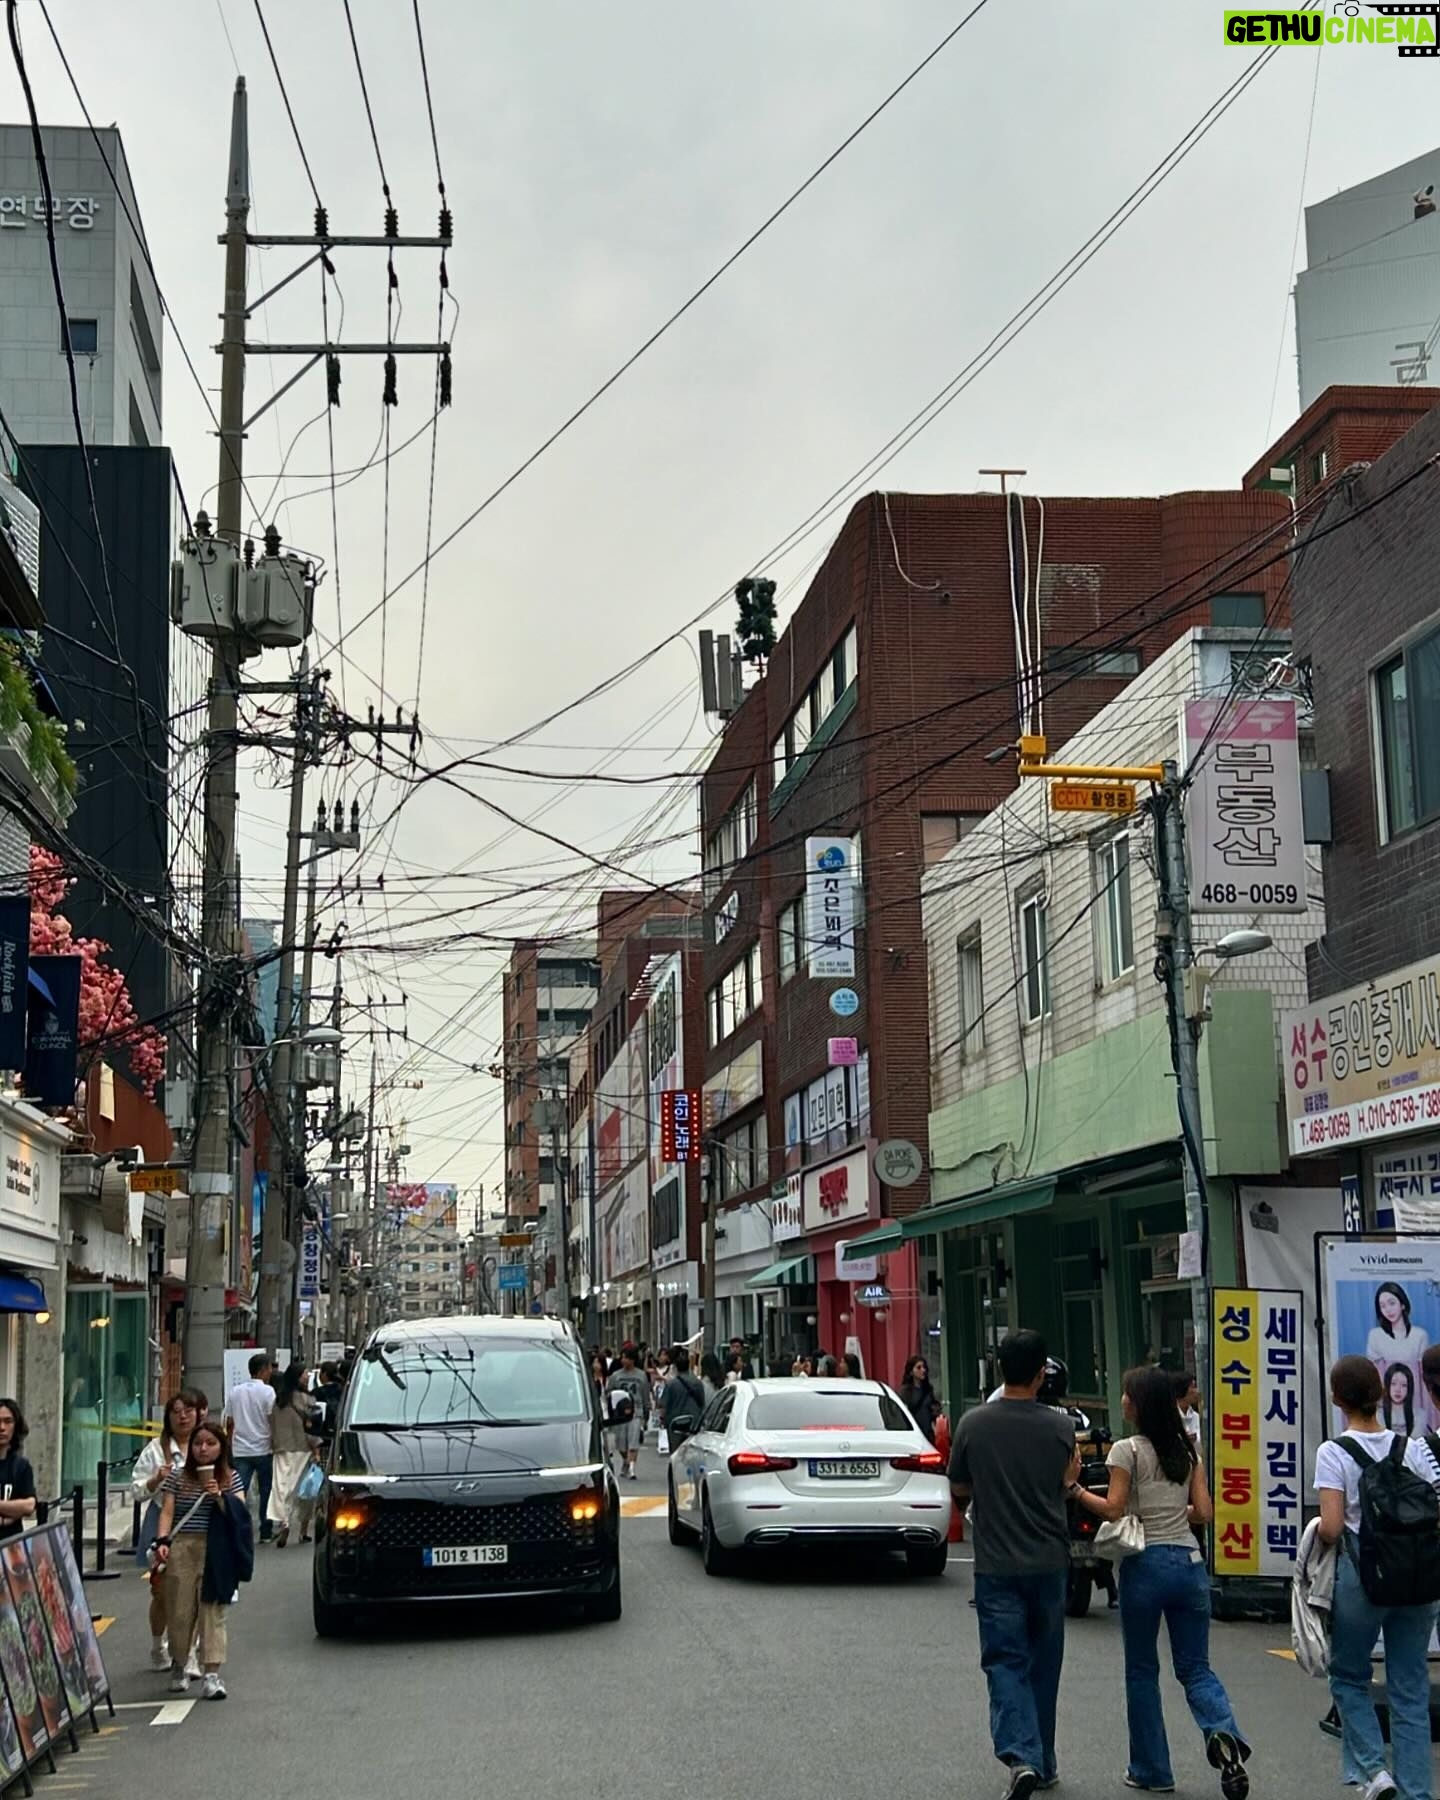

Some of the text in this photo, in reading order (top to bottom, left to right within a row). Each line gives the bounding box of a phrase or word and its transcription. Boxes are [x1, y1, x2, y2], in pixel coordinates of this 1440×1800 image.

[1057, 790, 1089, 806] CCTV
[1213, 743, 1281, 867] 부동산
[1201, 883, 1298, 905] 468-0059
[674, 1094, 690, 1149] 코인노래
[1300, 1111, 1351, 1148] T.468-0059
[677, 1151, 688, 1160] B1
[1379, 1155, 1424, 1201] 세무사
[1265, 1307, 1299, 1562] 세무사 김수택
[849, 1462, 877, 1474] 6563
[472, 1547, 505, 1561] 1138
